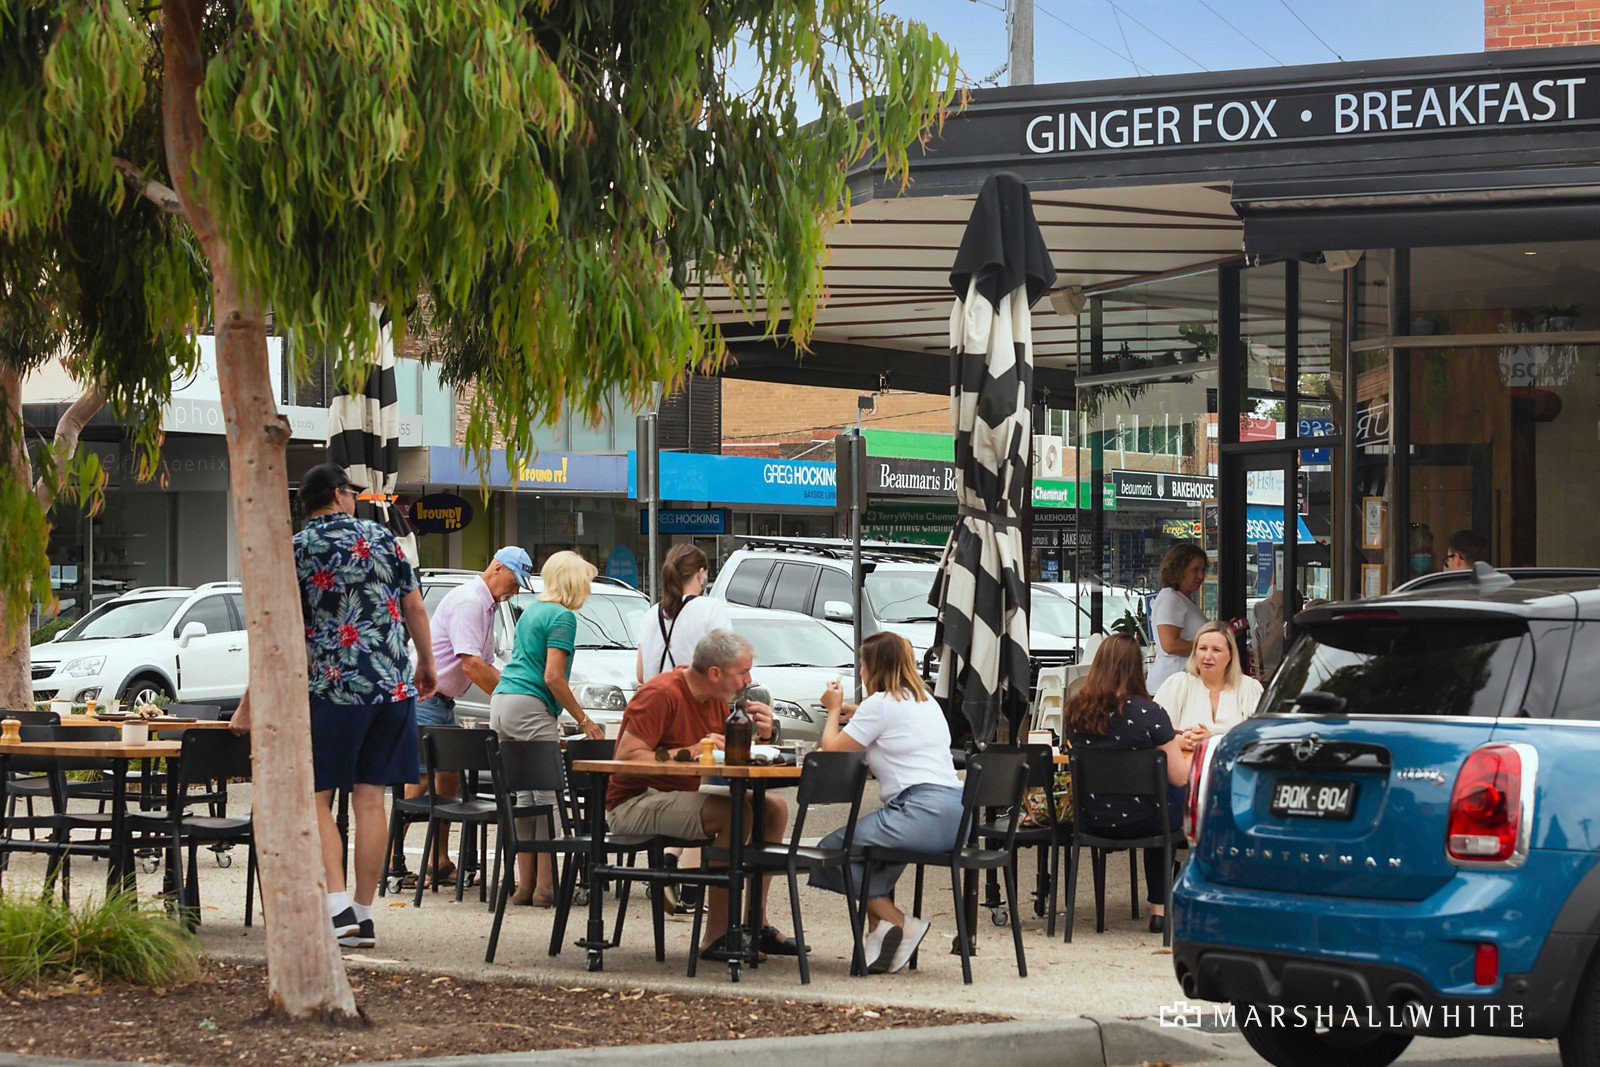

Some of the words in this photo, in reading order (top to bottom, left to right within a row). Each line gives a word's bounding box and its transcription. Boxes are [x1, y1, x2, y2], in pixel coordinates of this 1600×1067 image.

[1026, 105, 1181, 154] GINGER
[1193, 99, 1278, 143] FOX
[1335, 77, 1587, 134] BREAKFAST
[526, 468, 553, 482] FOUND
[763, 463, 794, 485] GREG
[880, 463, 940, 491] Beaumaris
[1035, 486, 1068, 503] Chemmart
[1121, 479, 1153, 496] beaumaris
[1172, 481, 1214, 498] BAKEHOUSE
[424, 508, 456, 520] FOUND
[675, 513, 720, 524] HOCKING
[879, 512, 925, 522] TerryWhite
[1034, 513, 1076, 522] BAKEHOUSE
[1216, 845, 1402, 869] COUNTRYMAN
